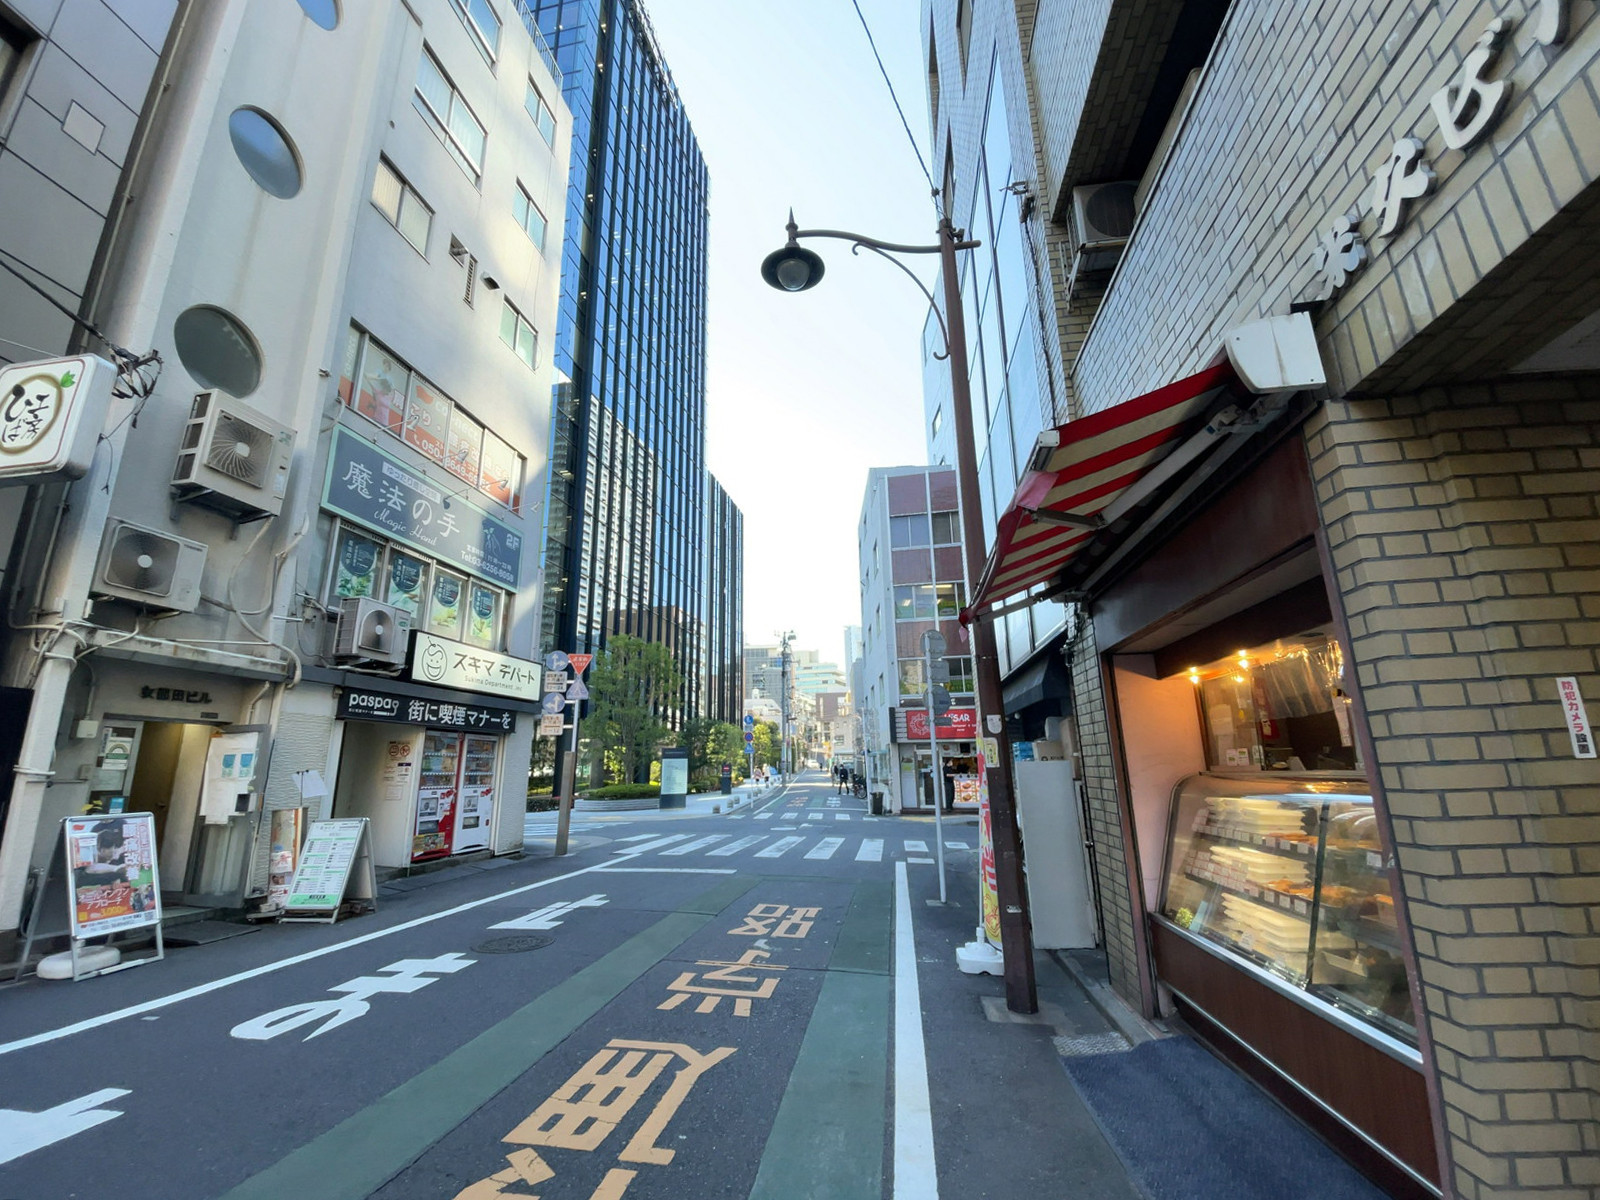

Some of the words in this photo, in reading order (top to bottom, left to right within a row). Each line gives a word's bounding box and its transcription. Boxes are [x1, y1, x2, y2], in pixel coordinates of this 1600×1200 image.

[342, 461, 460, 538] 魔法の手
[374, 508, 407, 533] Magic
[409, 524, 438, 546] Hand
[506, 533, 520, 550] 2F
[453, 652, 495, 677] スキマ
[499, 664, 535, 684] デパート
[349, 693, 392, 709] paspa
[408, 699, 511, 729] 街に喫煙マナーを
